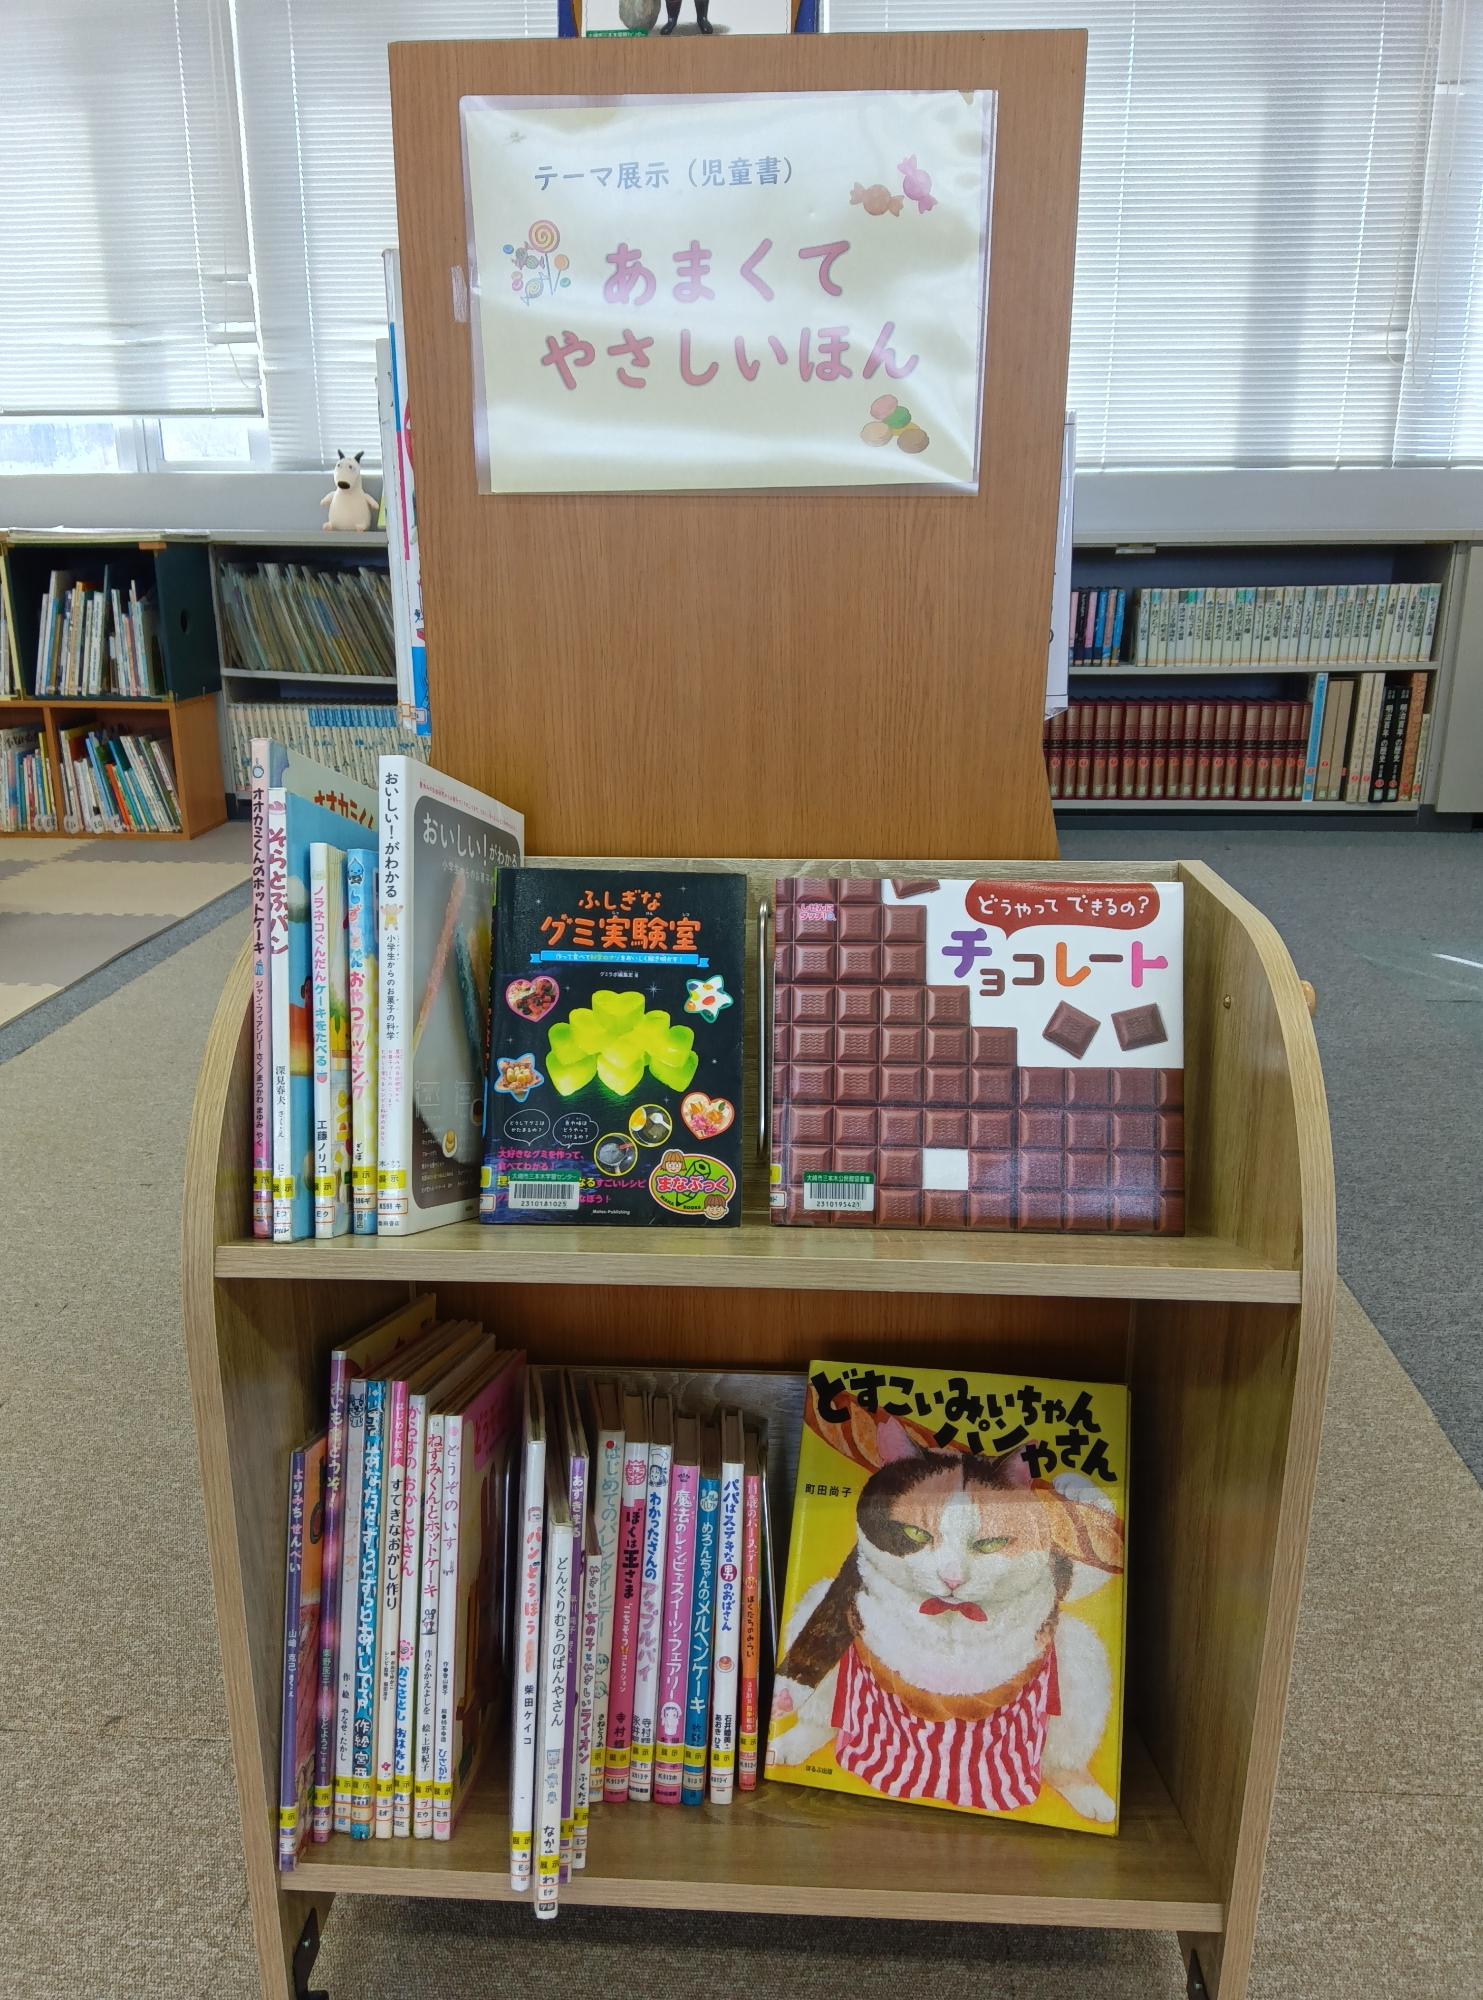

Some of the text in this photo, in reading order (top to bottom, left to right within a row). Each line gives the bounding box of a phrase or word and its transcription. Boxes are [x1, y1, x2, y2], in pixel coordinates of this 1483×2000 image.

[534, 156, 794, 192] テーマ展示（児童書）
[602, 237, 851, 305] あまくて
[540, 320, 920, 391] やさしいほん
[384, 771, 400, 898] おいしい！がわかる
[252, 787, 266, 955] オオカミくんのホットケーキ
[269, 827, 289, 956] そらとぶパン
[578, 889, 663, 912] ふしぎな
[978, 894, 1150, 918] どうやって できるの？
[540, 913, 702, 951] グミ実験室
[800, 903, 834, 912] しぜんに
[385, 934, 396, 1041] 小学生からのお菓子の科学
[942, 927, 1169, 997] チョコレート
[275, 1065, 286, 1105] 深見春夫
[317, 1120, 328, 1174] 工藤ノリコ
[656, 1175, 729, 1194] まなぶっく
[809, 1367, 1103, 1434] どすこいみいちゃん
[932, 1416, 1120, 1483] パンやさん
[289, 1467, 305, 1574] よりみちせんべい
[423, 1434, 443, 1598] ねずみくんとホットケーキ
[443, 1444, 460, 1551] どうぞのいす
[804, 1482, 853, 1499] 町田尚子
[385, 1478, 403, 1611] すてきなおかし作り
[597, 1446, 622, 1638] はじめてのバレンタインデー
[621, 1508, 641, 1599] ぼくは王さま
[720, 1478, 741, 1632] パパはステキな男のおばさん
[523, 1525, 543, 1637] パンどろぼう
[636, 1491, 663, 1682] わかったさんの アップルパイ
[666, 1490, 693, 1700] 魔法のレシピでスイーツ・フェアリー
[550, 1556, 569, 1727] どんぐりむらのぱんやさん
[689, 1522, 715, 1715] めろんちゃんのメルヘンケーキ
[746, 1595, 755, 1657] ぼくたちのみらい
[396, 1665, 410, 1722] かこさとし
[422, 1648, 433, 1715] 作・なかえよしを
[523, 1684, 535, 1745] 柴田ケイコ
[339, 1672, 351, 1762] 作・絵 やなせ・たかし
[543, 1824, 556, 1854] なか
